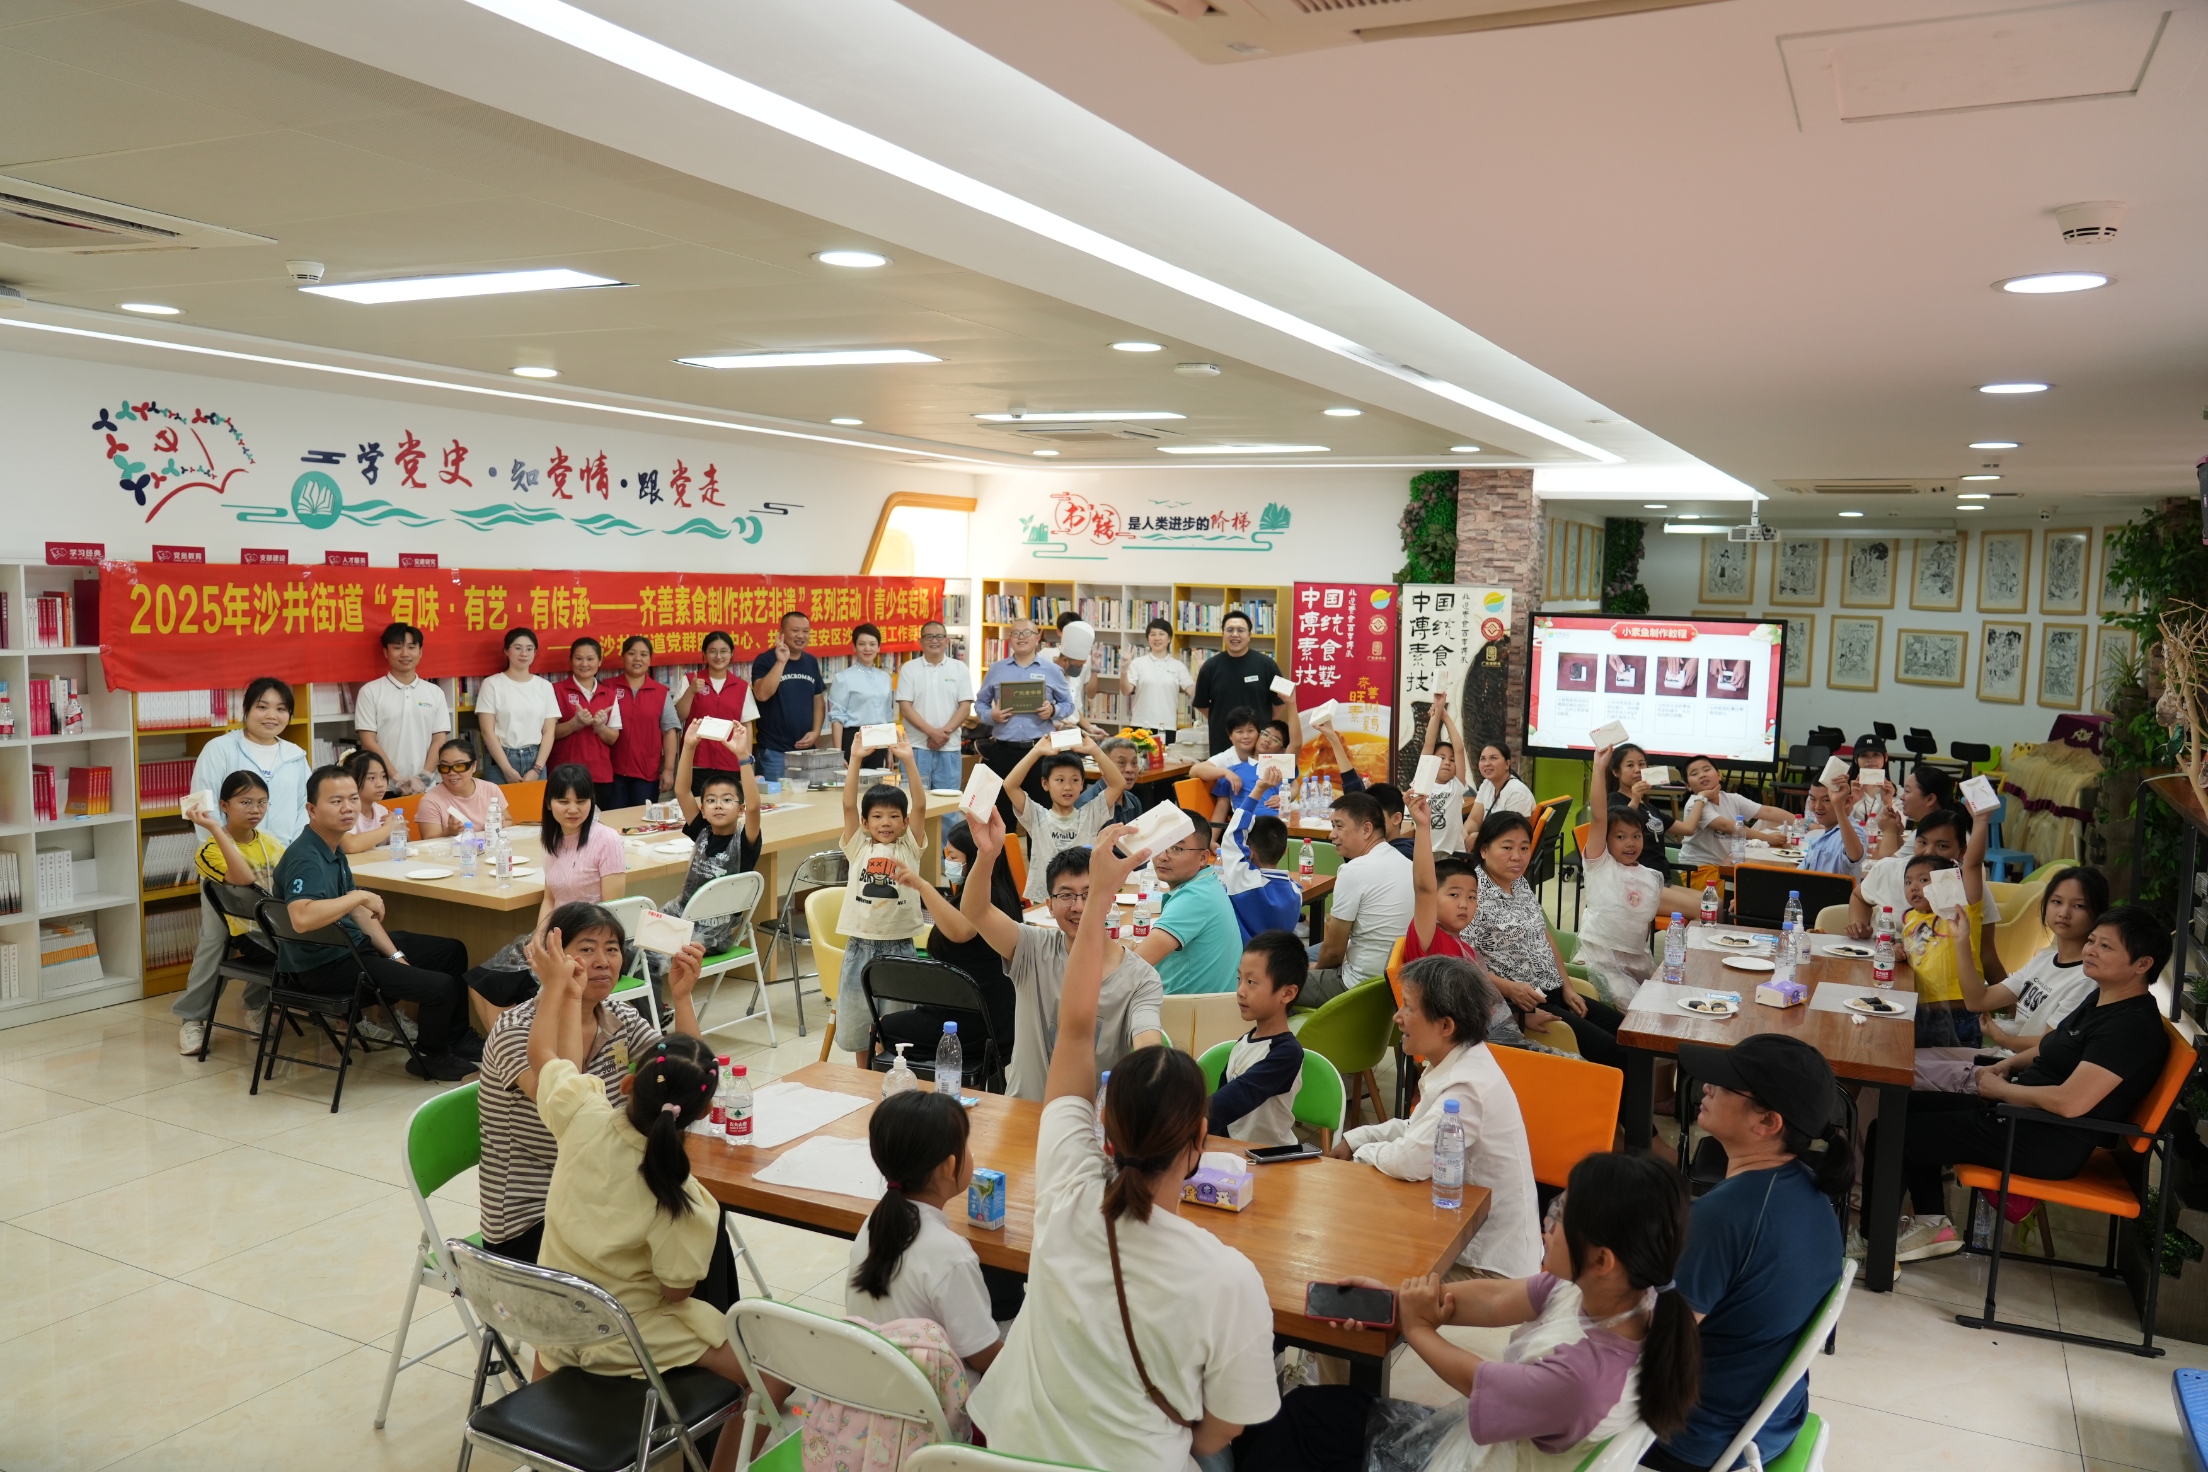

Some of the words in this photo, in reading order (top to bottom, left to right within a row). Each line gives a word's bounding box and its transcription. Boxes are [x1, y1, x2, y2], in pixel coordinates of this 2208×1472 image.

[69, 548, 102, 557] 学习经典
[173, 552, 203, 560] 党员教育
[259, 554, 286, 562] 支部建设
[342, 556, 366, 564] 人才服务
[414, 558, 437, 566] 党建研究
[1301, 586, 1345, 610] 中国
[1412, 590, 1455, 613] 中国
[1621, 626, 1688, 639] 小素鱼制作教程
[1297, 637, 1343, 661] 素食
[1409, 643, 1455, 667] 素食
[293, 878, 304, 894] 3
